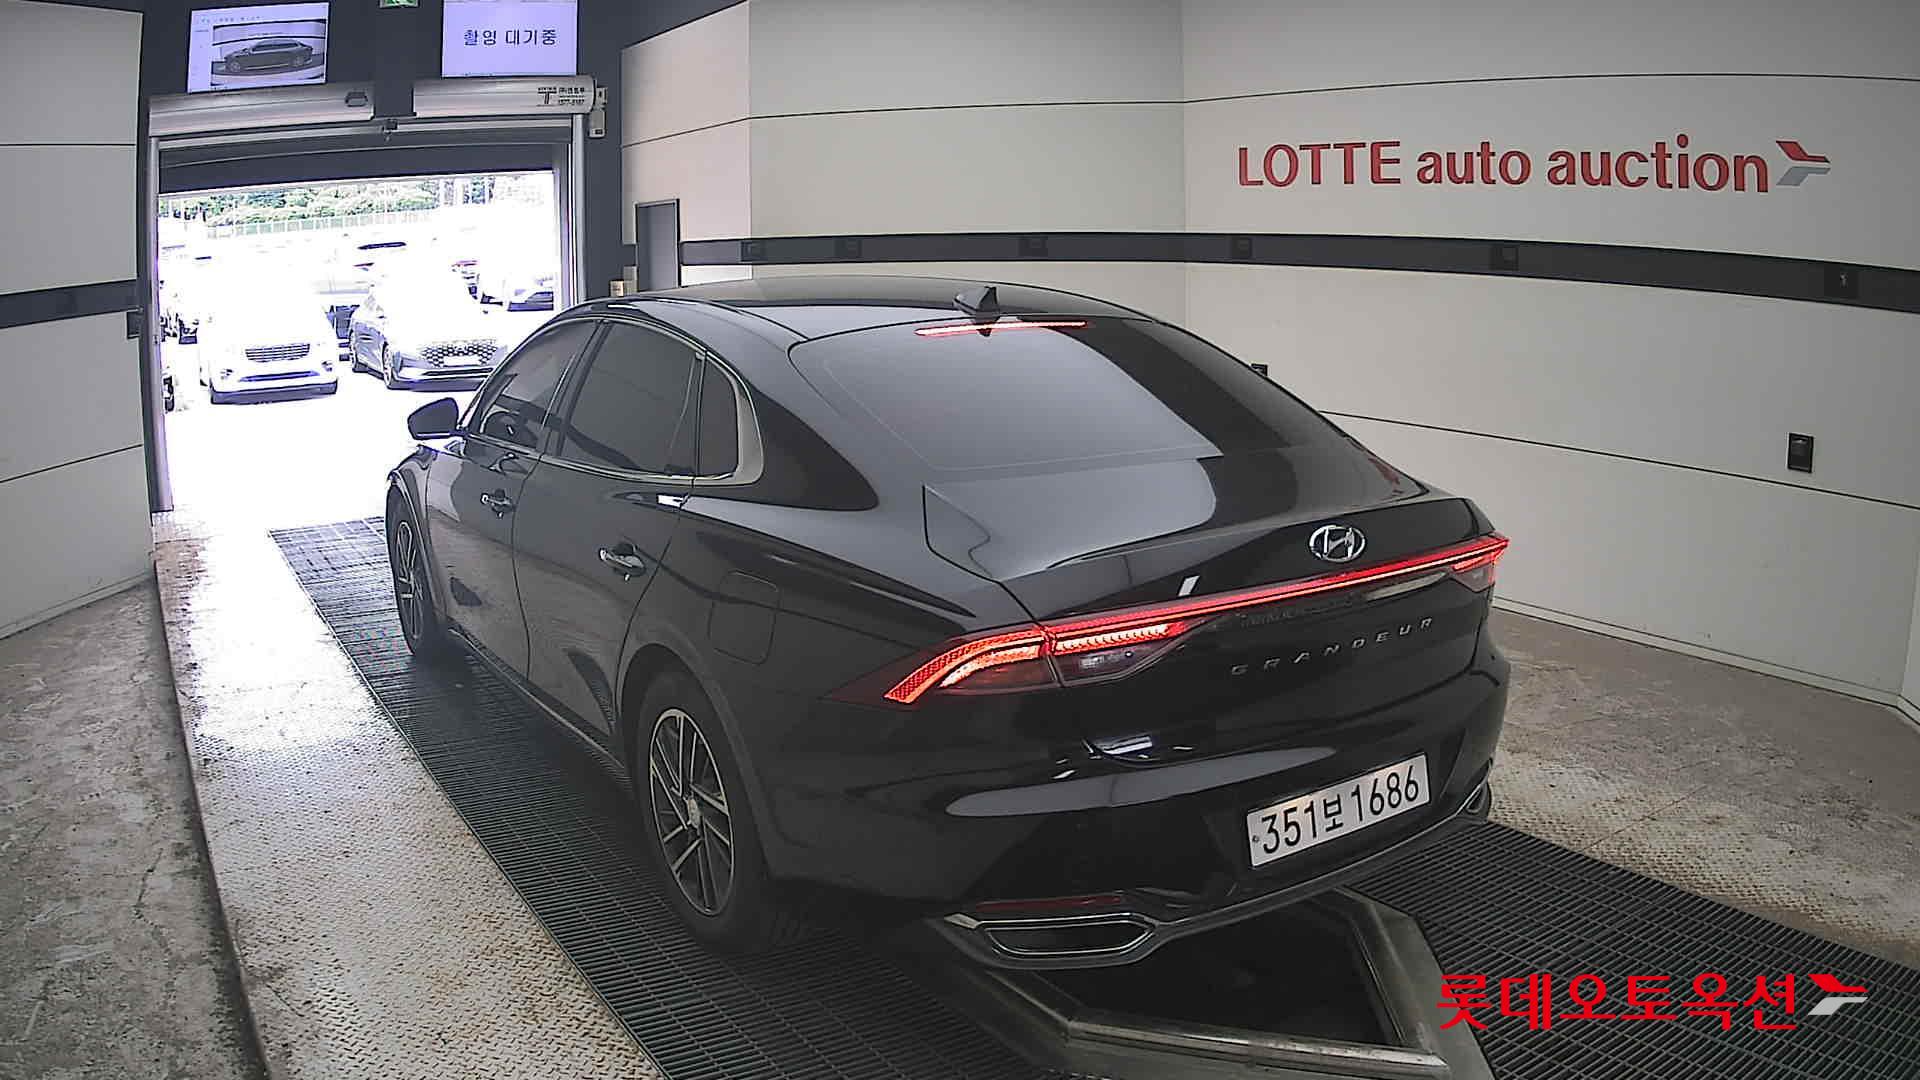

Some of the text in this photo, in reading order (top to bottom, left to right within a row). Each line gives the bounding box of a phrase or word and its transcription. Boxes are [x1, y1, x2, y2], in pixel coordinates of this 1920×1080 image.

[463, 28, 558, 46] 촬영 대기중
[1237, 133, 1769, 194] LOTTE auto auction
[1231, 616, 1433, 675] GRANDEUR
